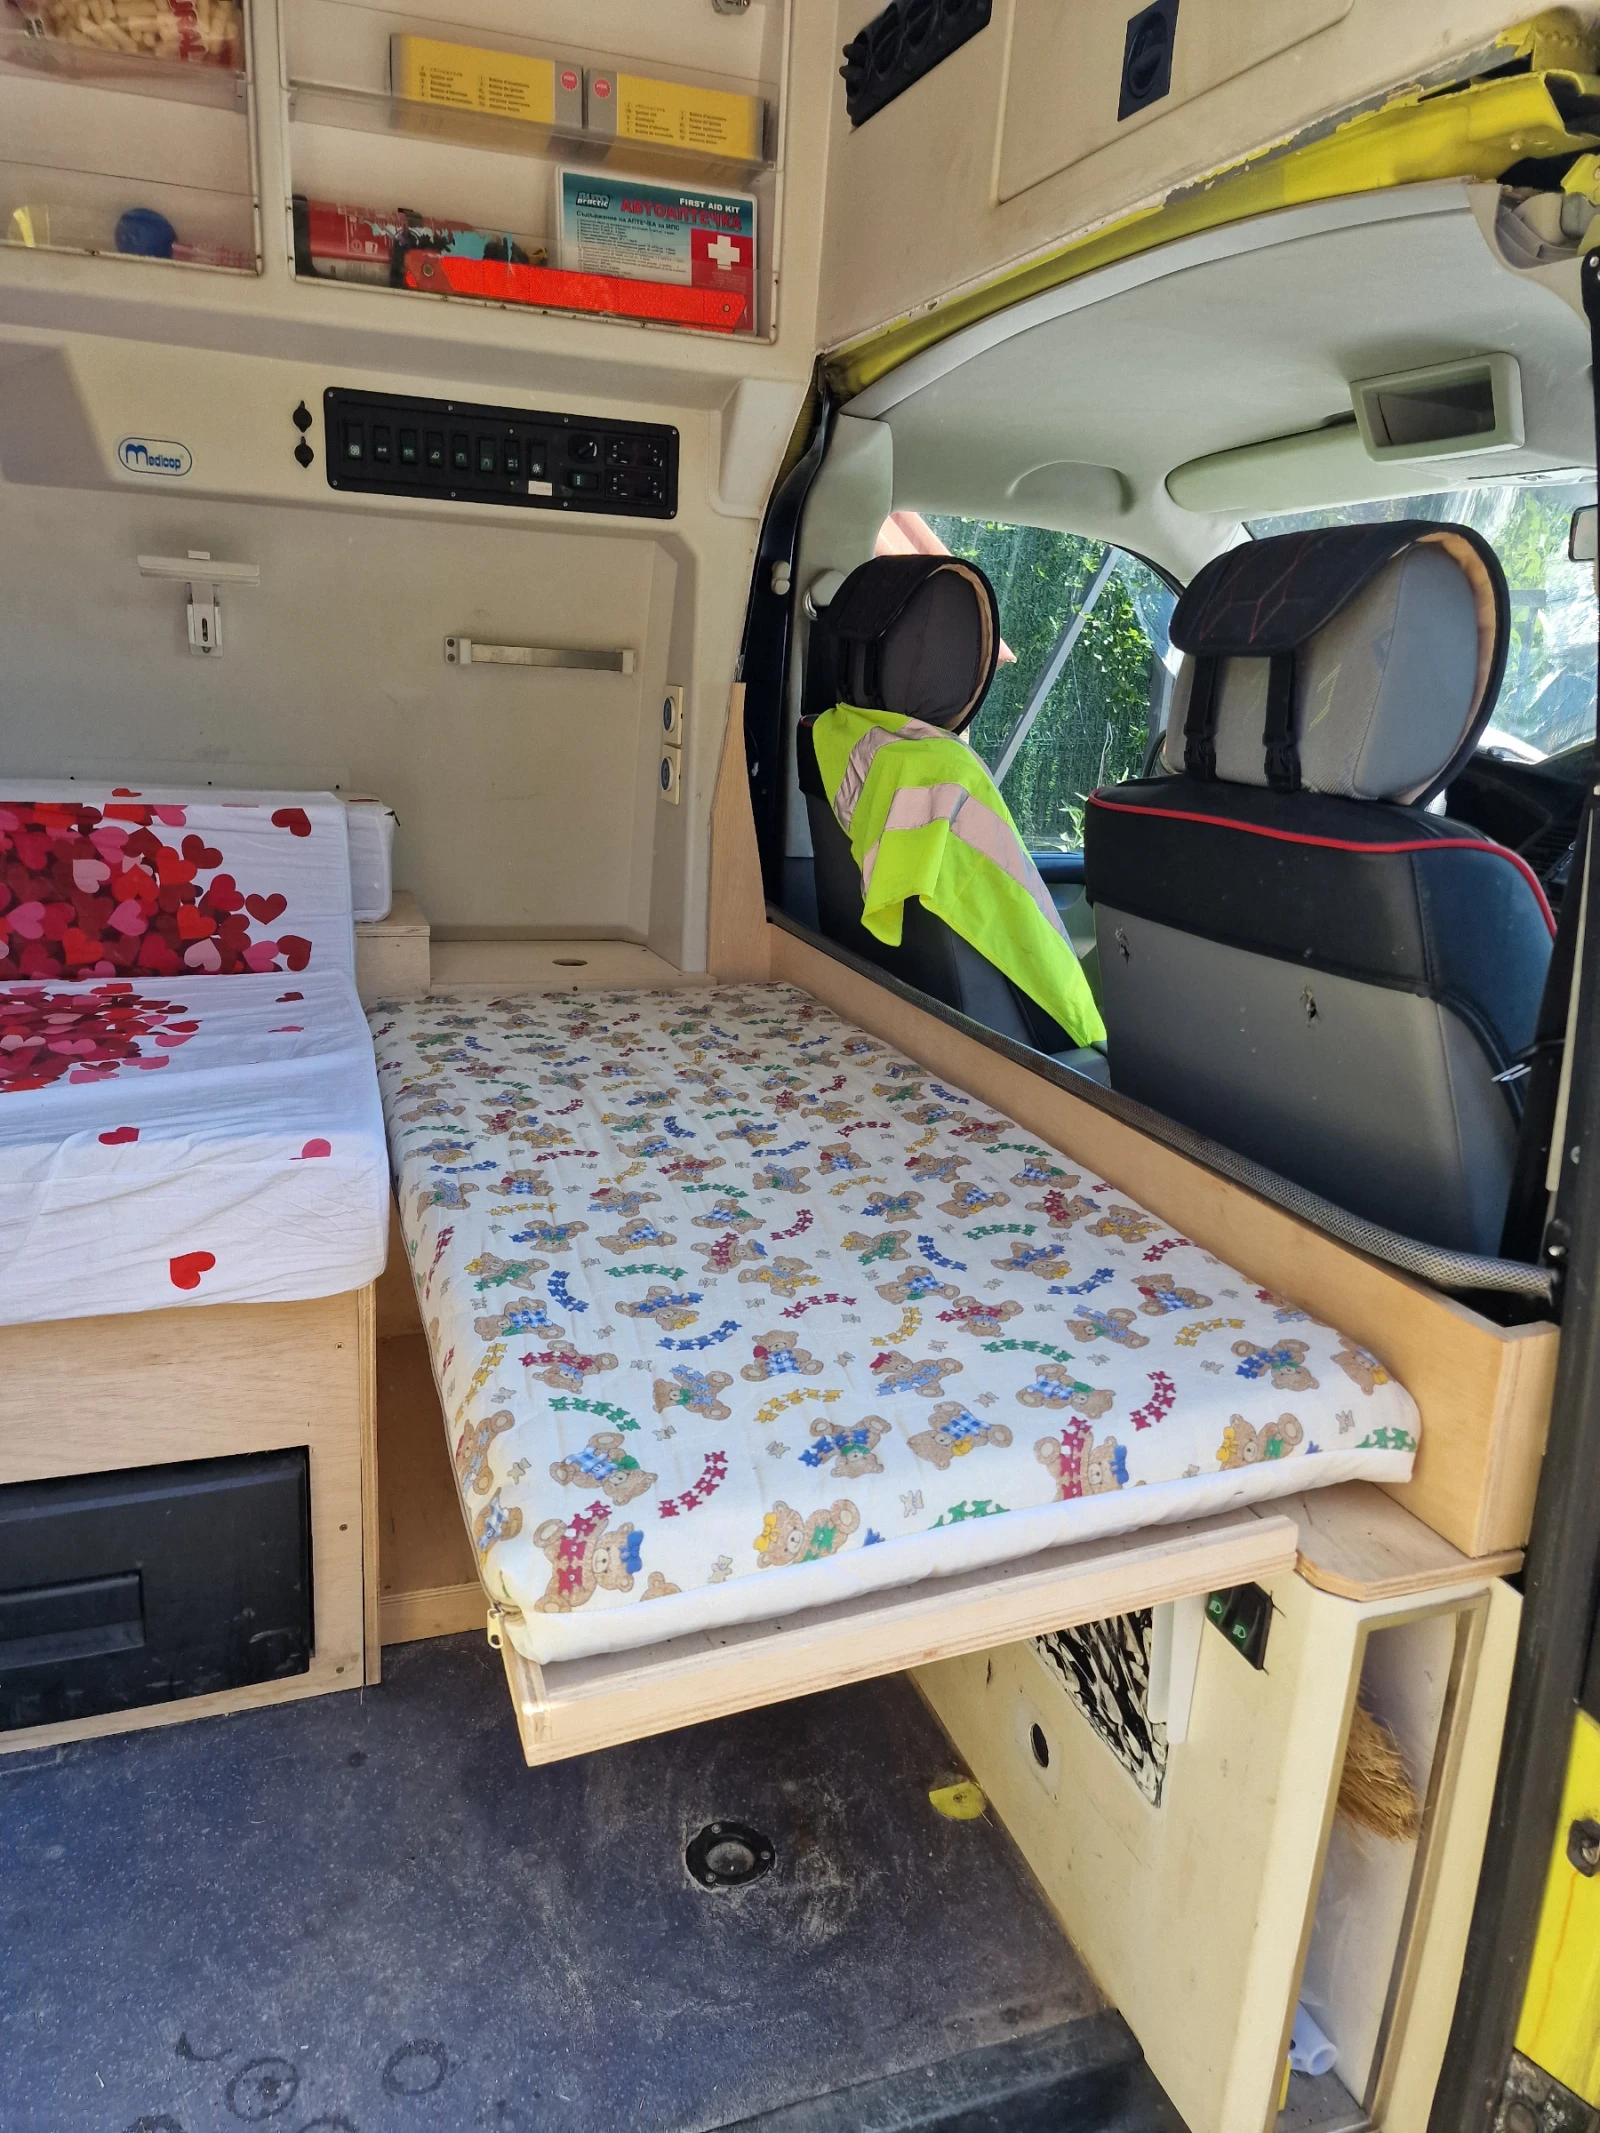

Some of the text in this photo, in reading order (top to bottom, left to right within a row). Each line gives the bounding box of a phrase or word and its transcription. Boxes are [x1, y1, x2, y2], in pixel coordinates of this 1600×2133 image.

[620, 197, 743, 231] АВТОАПТЕЧКА
[679, 197, 741, 214] FIRST AID KIT
[125, 443, 182, 471] Medicop
